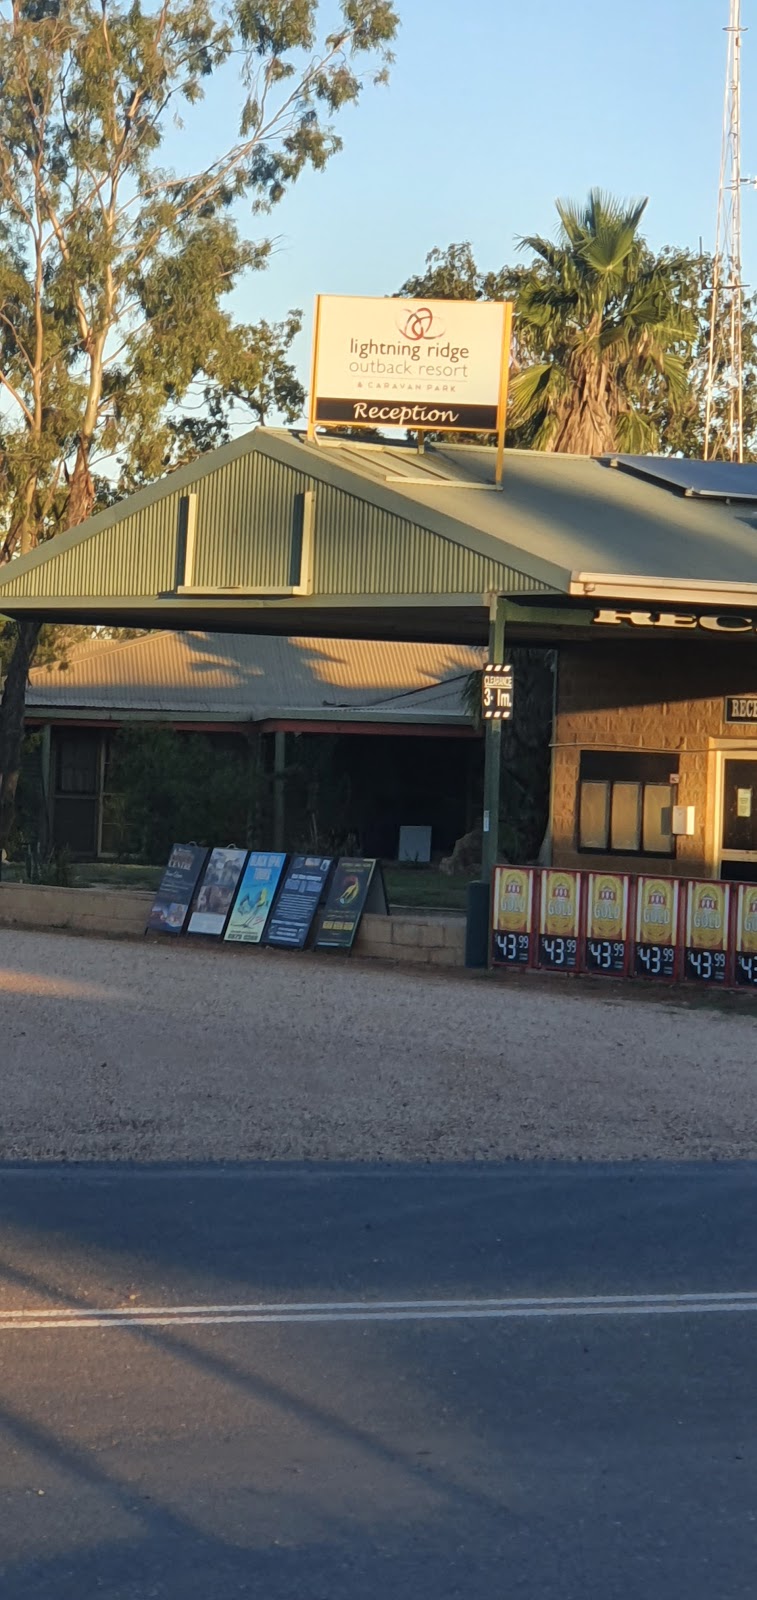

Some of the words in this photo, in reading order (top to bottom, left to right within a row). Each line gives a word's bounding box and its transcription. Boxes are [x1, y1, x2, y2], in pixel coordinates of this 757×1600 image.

[350, 338, 421, 361] lightning
[427, 342, 469, 363] ridge
[349, 359, 412, 374] outback
[418, 364, 468, 378] resort
[368, 382, 422, 390] CARAVAN
[427, 384, 456, 392] PARK
[353, 402, 459, 425] Reception
[593, 609, 757, 632] REC
